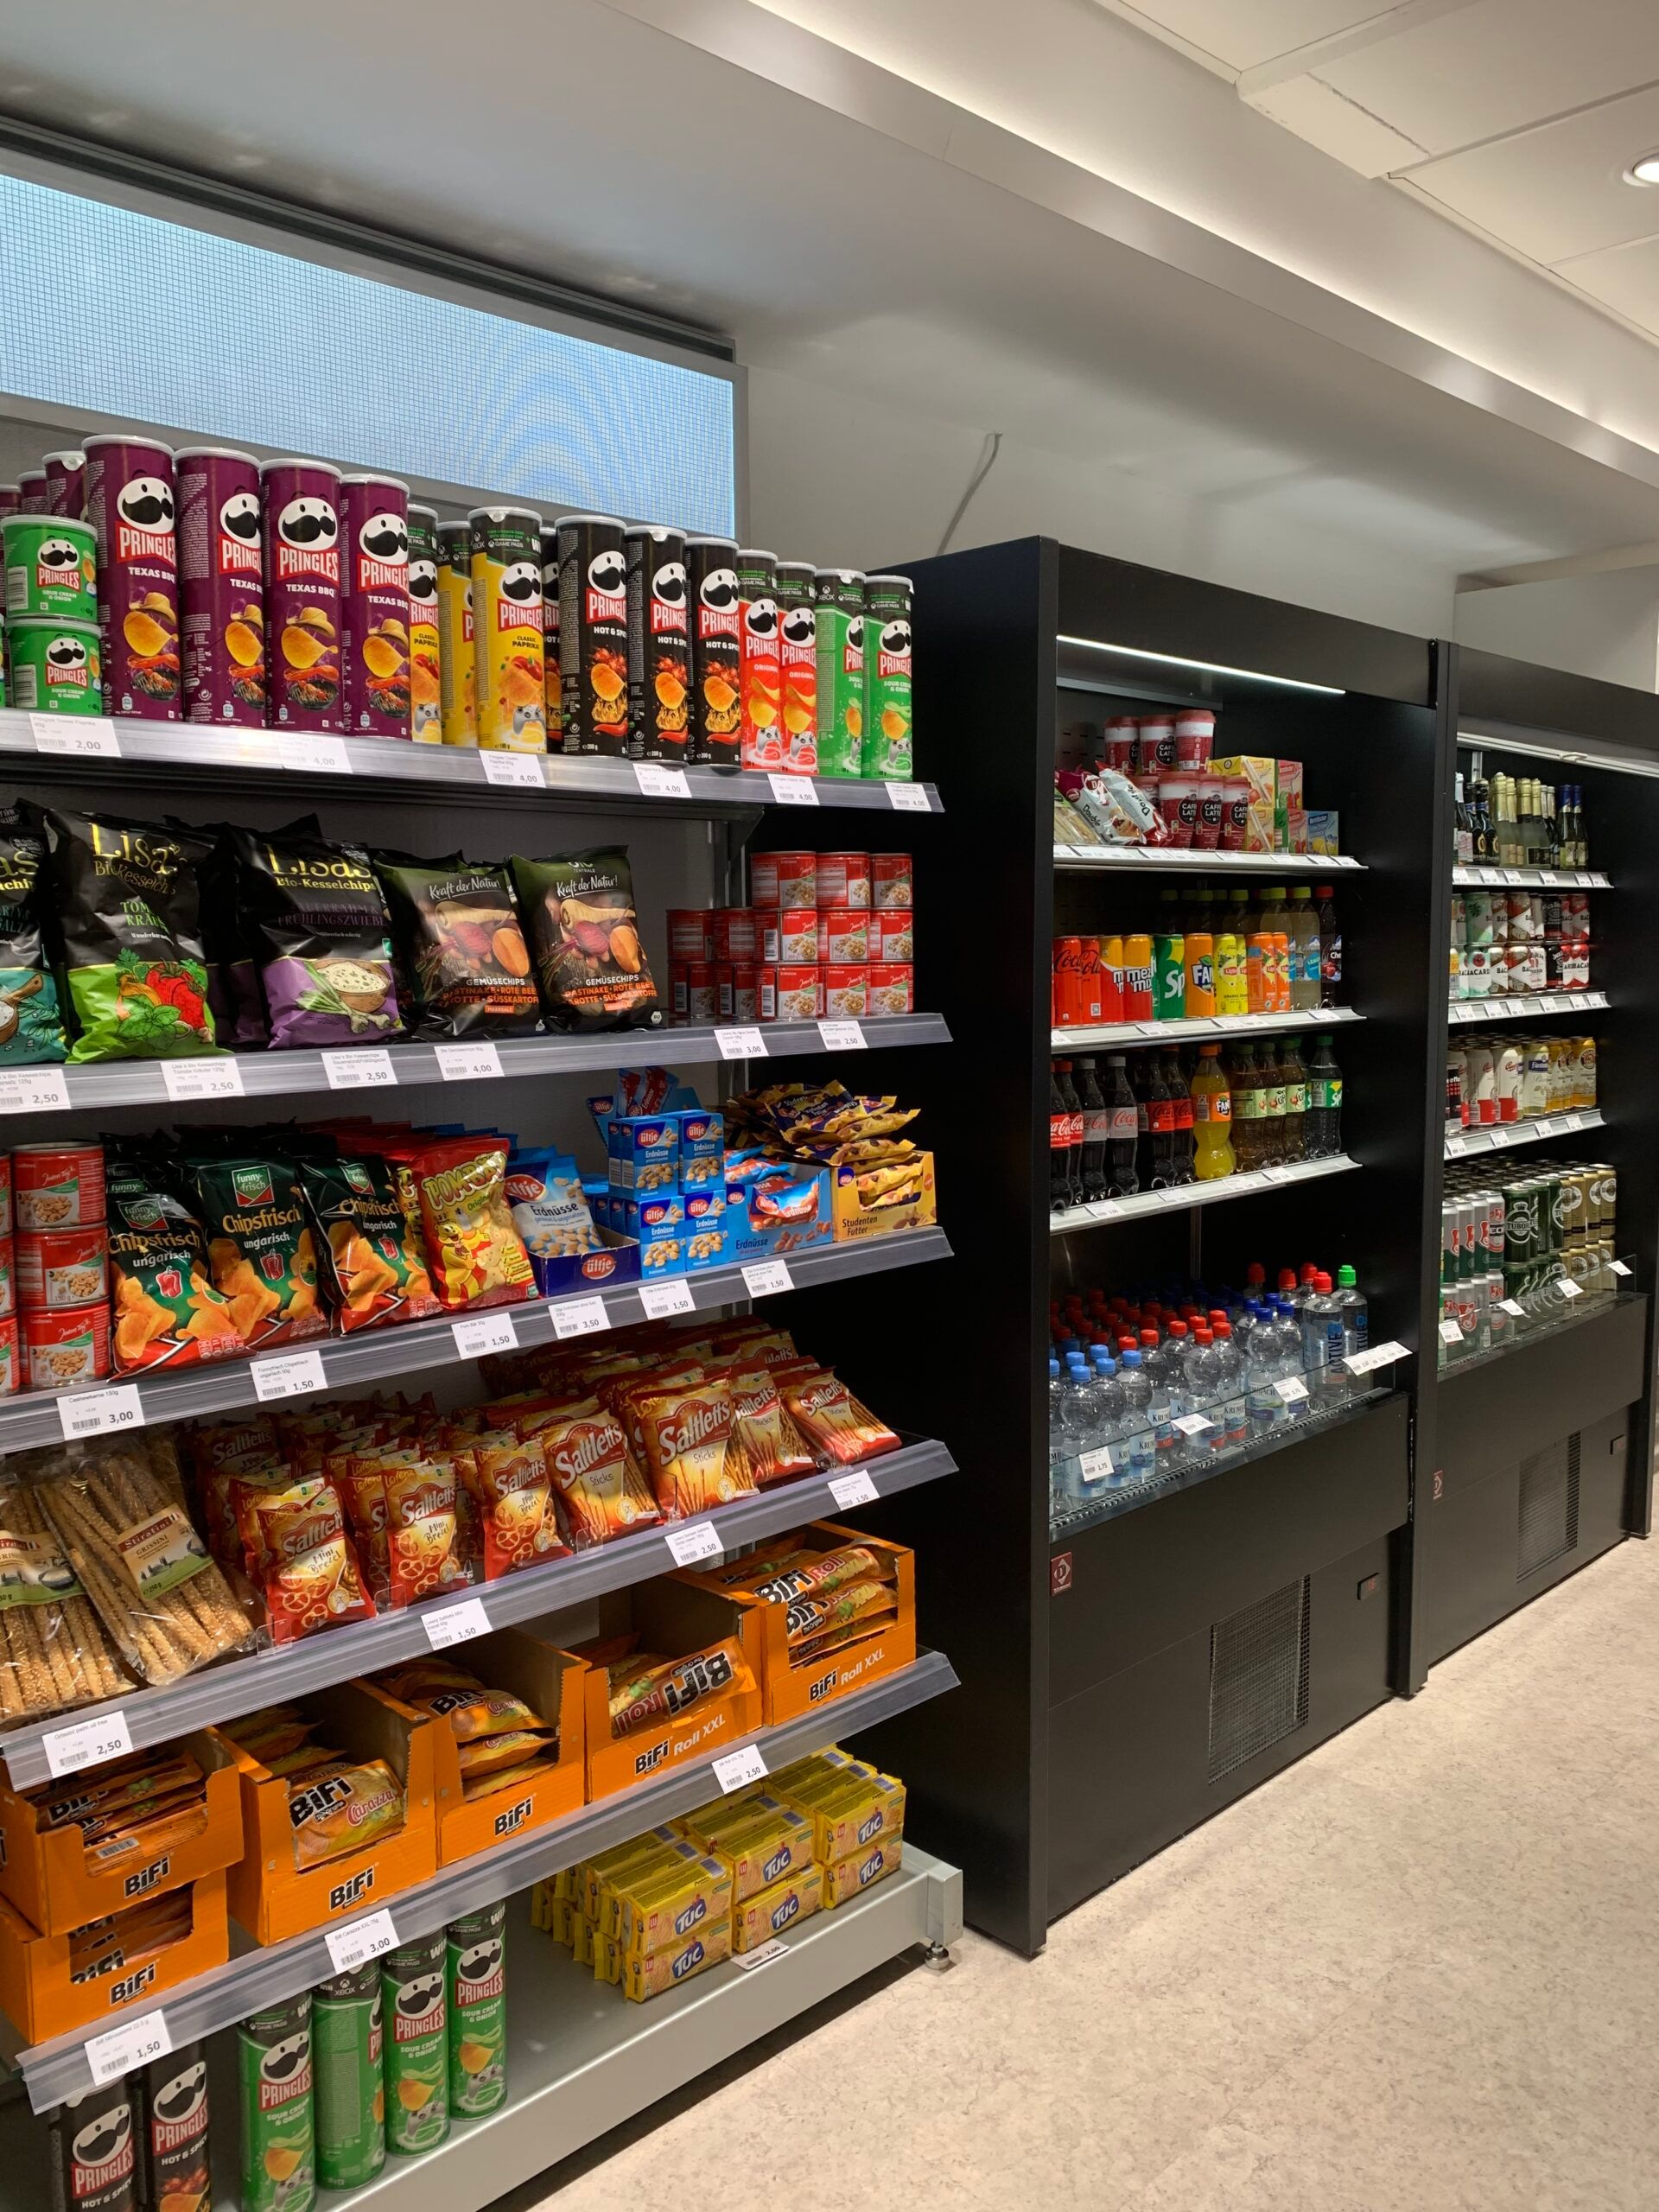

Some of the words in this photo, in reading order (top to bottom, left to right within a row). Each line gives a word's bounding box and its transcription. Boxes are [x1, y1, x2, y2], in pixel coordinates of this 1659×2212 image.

[128, 567, 160, 578] TEXAS
[280, 547, 338, 582] PRINGLES
[38, 569, 79, 590] PRINGLES
[230, 579, 256, 590] TEXAS
[286, 584, 316, 594] TEXAS
[318, 586, 334, 597] BBQ
[367, 595, 396, 606] TEXAS
[500, 604, 544, 631] PRINGLES
[48, 667, 87, 689] PRINGLES
[75, 740, 101, 750] 2,00
[313, 757, 335, 766] 4,00
[519, 775, 537, 784] 4,00
[1082, 804, 1101, 827] Double
[276, 876, 376, 892] Bio-Kesselchips
[429, 881, 454, 899] Kraft
[454, 879, 470, 893] der
[556, 881, 577, 899] Kraft
[577, 879, 591, 892] der
[591, 874, 618, 892] Natur!
[466, 977, 525, 987] GEMÜSECHIPS
[586, 975, 639, 987] GEMÜSECHIPS
[1126, 968, 1151, 983] mez
[366, 1071, 387, 1082] 2,50
[473, 1065, 492, 1073] 4,00
[211, 1081, 234, 1092] 2,50
[32, 1093, 59, 1105] 2,50
[640, 1131, 658, 1145] ültje
[689, 1125, 705, 1138] ültje
[645, 1148, 669, 1159] Erdnüsse
[694, 1142, 715, 1153] Erdnüsse
[236, 1173, 264, 1185] funny-
[241, 1179, 268, 1192] frisch
[111, 1182, 142, 1194] funny-
[530, 1201, 579, 1217] Erdnüsse
[646, 1209, 664, 1222] ültje
[690, 1201, 708, 1214] ültje
[222, 1206, 302, 1236] Chipsfrisch
[696, 1218, 718, 1230] Erdnüsse
[842, 1215, 878, 1229] Studenten
[1506, 1222, 1530, 1230] TUBOR
[652, 1225, 675, 1236] Erdnüsse
[847, 1225, 868, 1237] Futter
[108, 1230, 200, 1255] Chipsfrisch
[244, 1232, 290, 1249] ungarisch
[735, 1236, 768, 1250] Erdnüsse
[132, 1250, 191, 1268] ungarisch
[585, 1257, 612, 1275] ültje
[770, 1280, 785, 1288] 1,50
[673, 1300, 689, 1310] 1,50
[582, 1319, 600, 1329] 3,50
[492, 1335, 510, 1346] 1,50
[1357, 1325, 1368, 1351] TIVE
[1328, 1332, 1343, 1374] ACTIVE
[292, 1380, 314, 1392] 1,50
[800, 1381, 843, 1417] Saltletts
[109, 1410, 133, 1424] 3,00
[659, 1398, 731, 1466] Saltletts
[555, 1422, 623, 1489] Saltletts
[693, 1449, 716, 1465] Sticks
[1097, 1462, 1108, 1471] 1,75
[494, 1457, 546, 1498] Saltletts
[589, 1471, 614, 1487] Sticks
[400, 1484, 455, 1527] Saltletts
[518, 1496, 541, 1516] Brezel
[521, 1494, 535, 1506] Mini
[856, 1493, 869, 1503] 1,50
[124, 1516, 171, 1549] Stiratini
[428, 1520, 445, 1533] Mini
[423, 1524, 450, 1546] Brezel
[136, 1534, 168, 1557] GRISSINI
[701, 1542, 717, 1554] 2,50
[308, 1552, 342, 1576] Brezel
[312, 1547, 334, 1566] Mini
[810, 1555, 844, 1580] Roll
[755, 1568, 813, 1605] BiFi
[458, 1626, 476, 1639] 1,50
[668, 1651, 734, 1714] BiFi
[809, 1668, 838, 1703] BiFi
[841, 1662, 863, 1686] Roll
[864, 1647, 885, 1670] XXL
[614, 1691, 661, 1732] Roll
[97, 1738, 122, 1755] 2,50
[634, 1738, 670, 1777] BiFi
[673, 1731, 701, 1757] Roll
[702, 1713, 726, 1737] XXL
[747, 1766, 761, 1778] 2,50
[290, 1776, 353, 1830] BiFi
[346, 1789, 396, 1827] Carazza
[494, 1797, 533, 1838] BiFi
[837, 1825, 844, 1835] LU
[858, 1815, 882, 1842] TUC
[741, 1864, 747, 1873] LU
[764, 1853, 791, 1882] TUC
[860, 1853, 882, 1883] TUC
[124, 1855, 170, 1899] BiFi
[330, 1867, 374, 1911] BiFi
[677, 1906, 704, 1934] TUC
[772, 1899, 798, 1929] TUC
[369, 1937, 390, 1953] 3,00
[675, 1948, 702, 1979] TUC
[110, 1961, 156, 2006] BiFi
[457, 1971, 504, 2005] PRINGLES
[396, 2005, 445, 2041] PRINGLES
[137, 2040, 161, 2059] 1,50
[261, 2069, 311, 2109] PRINGLES
[156, 2100, 208, 2152] PRINGLES
[74, 2141, 134, 2195] PRINGLES
[162, 2155, 181, 2166] HOT
[82, 2196, 102, 2209] HOT
